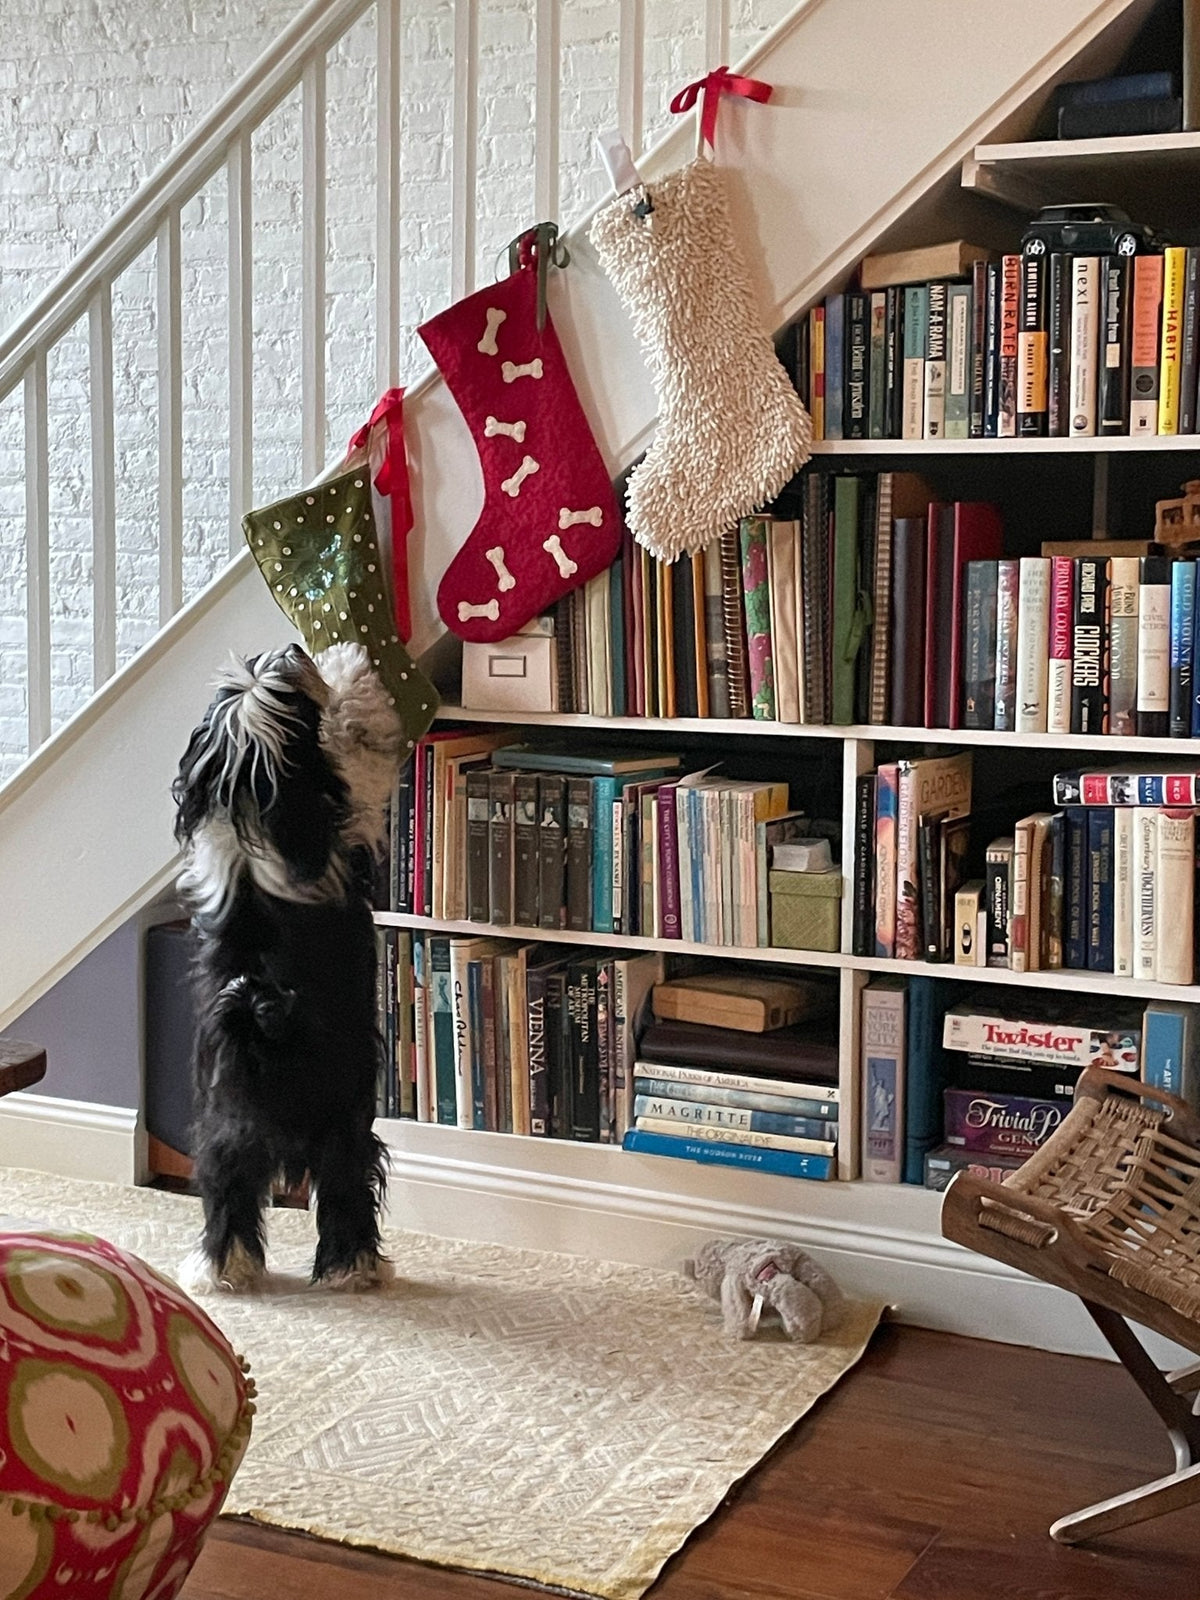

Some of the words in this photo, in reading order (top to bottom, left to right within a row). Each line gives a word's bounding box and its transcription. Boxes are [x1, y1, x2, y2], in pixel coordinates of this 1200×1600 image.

[1003, 256, 1017, 303] BURN
[1077, 264, 1089, 306] next
[929, 285, 944, 358] NAM-A-RAMA
[1003, 310, 1017, 355] RATE
[1165, 309, 1178, 361] HABIT
[1055, 560, 1070, 608] PRIMARY
[1182, 574, 1194, 612] COLD
[1053, 611, 1067, 658] COLORS
[1180, 614, 1193, 687] MOUNTAIN
[1073, 625, 1101, 687] CLOCKERS
[1145, 777, 1153, 803] BLUE
[1172, 780, 1181, 801] RED
[994, 876, 1003, 929] ORNAMENT
[1140, 871, 1154, 937] TOGETHERNESS
[581, 973, 589, 1043] METROPOLITAN
[615, 967, 625, 1017] AMERICAN
[529, 997, 545, 1077] VIENNA
[867, 1022, 898, 1033] YORK
[868, 1011, 897, 1021] NEW
[867, 1032, 897, 1044] CITY
[983, 1023, 1083, 1052] Twister
[714, 1074, 749, 1088] AMERICA
[1163, 1069, 1172, 1088] ART
[650, 1103, 749, 1126] MAGRITTE
[965, 1099, 1038, 1131] Trivial
[685, 1145, 702, 1153] THE
[998, 1132, 1040, 1147] GEN
